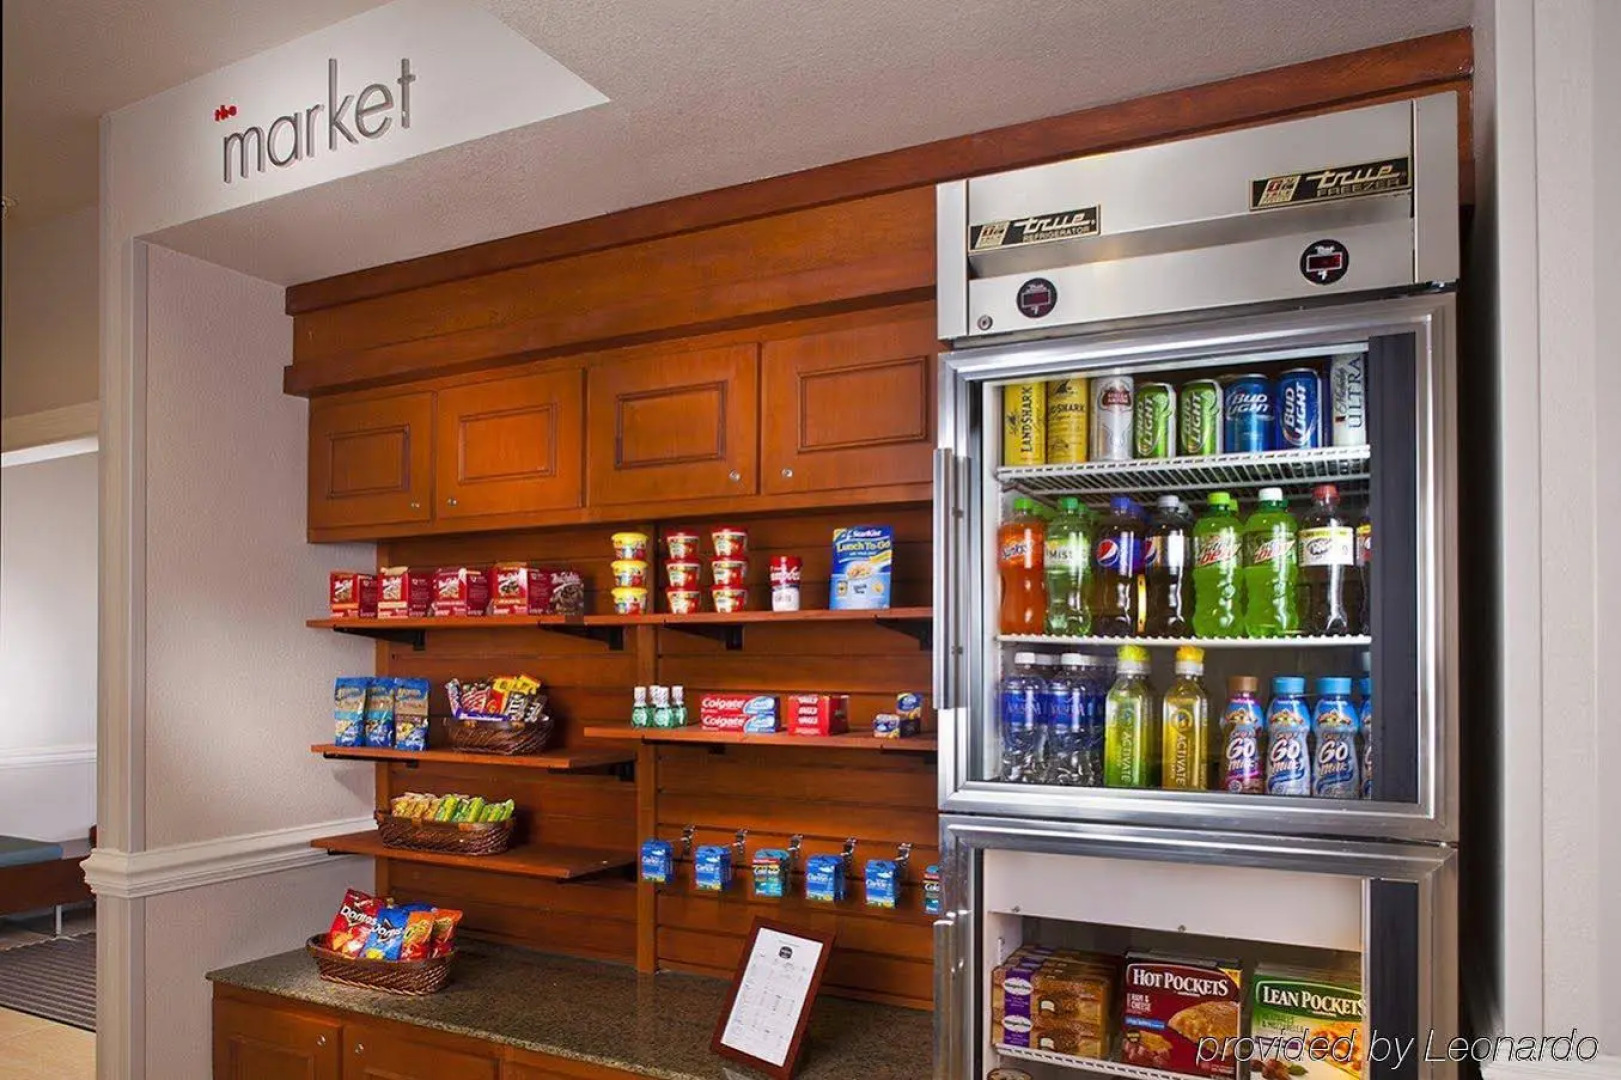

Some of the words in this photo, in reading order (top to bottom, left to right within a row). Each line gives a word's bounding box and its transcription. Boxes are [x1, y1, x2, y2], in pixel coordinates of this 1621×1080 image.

[223, 57, 417, 184] market
[1317, 178, 1400, 198] FREEZER
[1022, 225, 1091, 243] REFRIGERATOR
[1235, 393, 1268, 404] BUD
[1347, 356, 1363, 428] ULTRA
[1020, 385, 1033, 453] LANDSHARK
[1284, 386, 1295, 428] BUD
[1294, 380, 1307, 441] LIGHT
[701, 698, 746, 710] Colgate
[702, 716, 746, 728] Colgate
[1121, 731, 1133, 784] ACTIVATE
[1175, 732, 1188, 786] ACTIVATE
[340, 904, 378, 928] Doritos
[1132, 968, 1163, 988] HOT
[1163, 971, 1229, 997] POCKETS
[1262, 985, 1299, 1008] LEAN
[1301, 990, 1367, 1016] POCKETS
